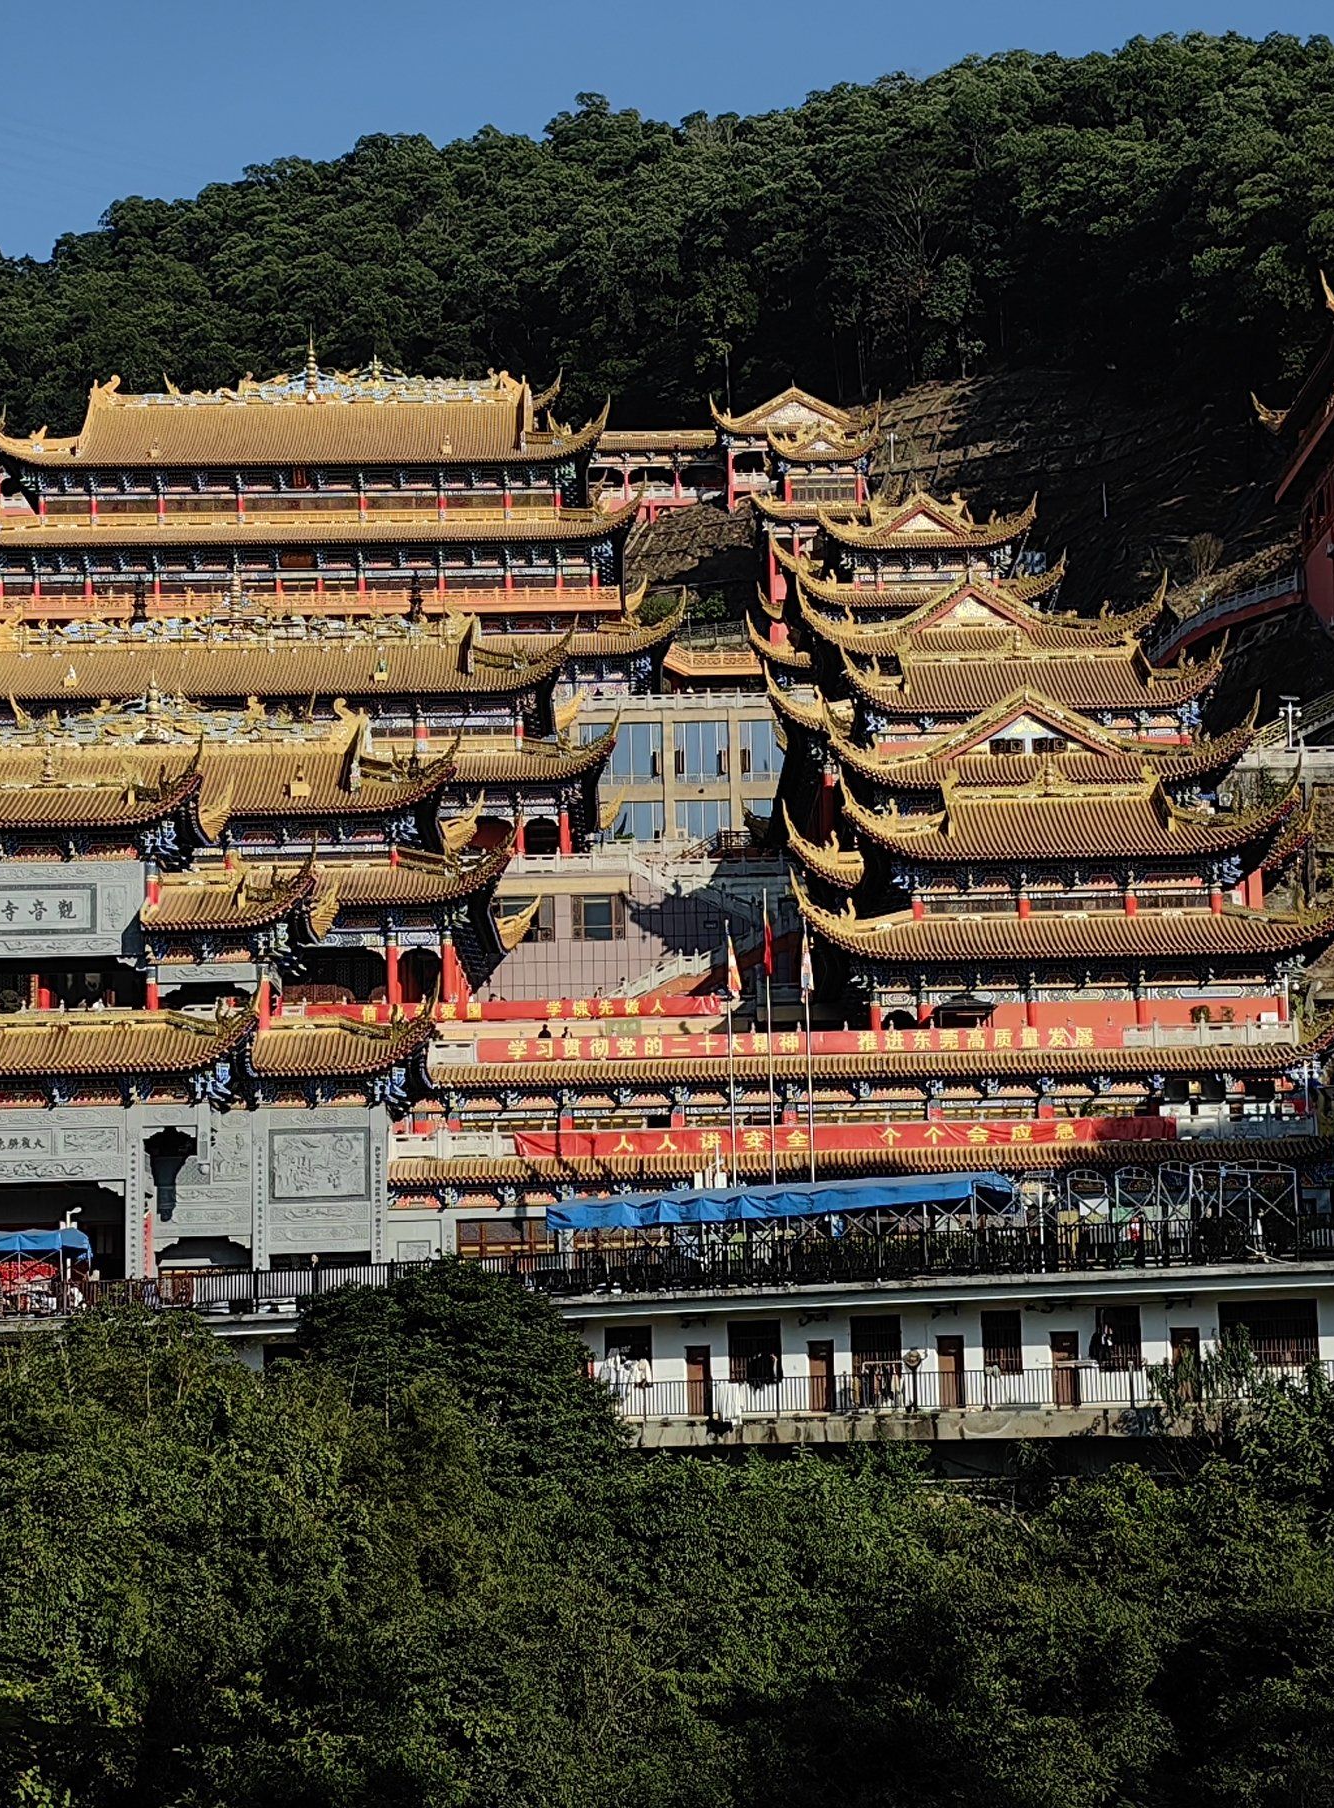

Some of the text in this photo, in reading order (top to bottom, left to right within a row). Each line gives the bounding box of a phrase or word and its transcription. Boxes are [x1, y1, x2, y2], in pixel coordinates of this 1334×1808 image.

[546, 999, 666, 1018] 学佛先做人
[508, 1026, 1095, 1060] 学习贯彻党的二十大精神 推进东莞高质量发展
[613, 1122, 1077, 1152] 人人讲安全 个个会应急
